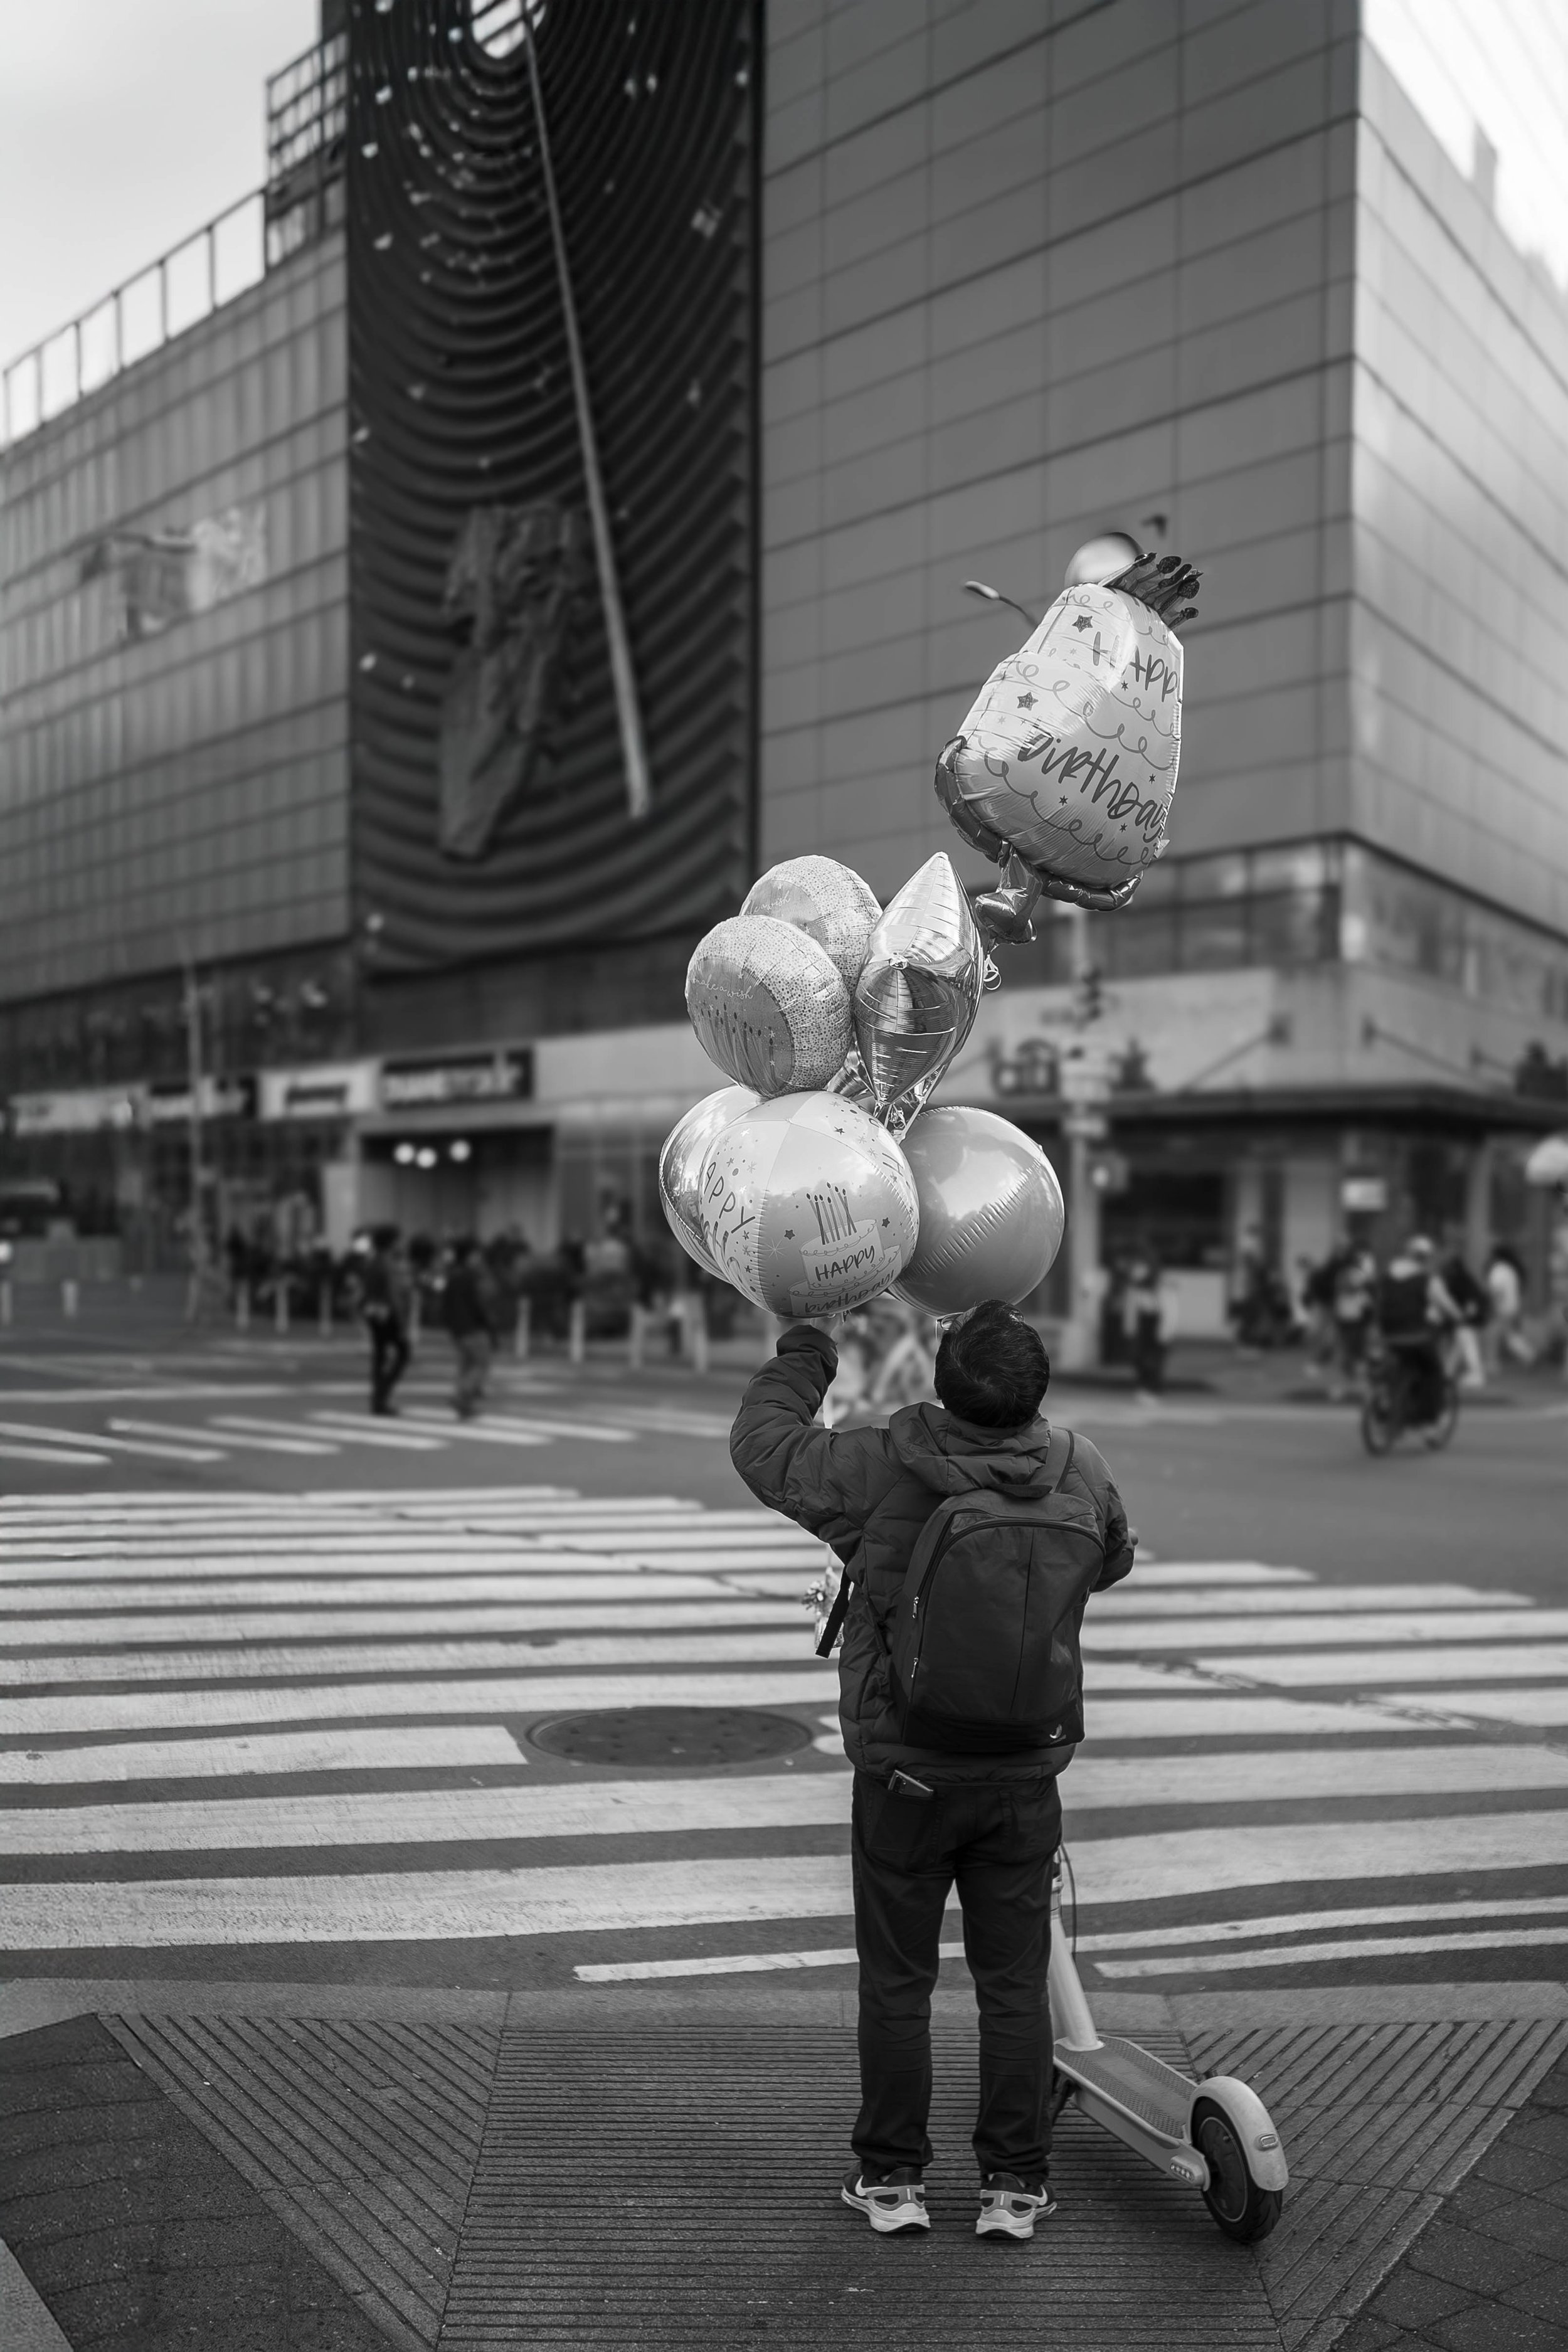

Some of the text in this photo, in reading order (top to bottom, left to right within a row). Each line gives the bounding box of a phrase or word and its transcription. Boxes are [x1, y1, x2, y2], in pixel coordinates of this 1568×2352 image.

[726, 985, 753, 1000] wish
[702, 1161, 756, 1234] APPY
[815, 1245, 875, 1281] HAPPY
